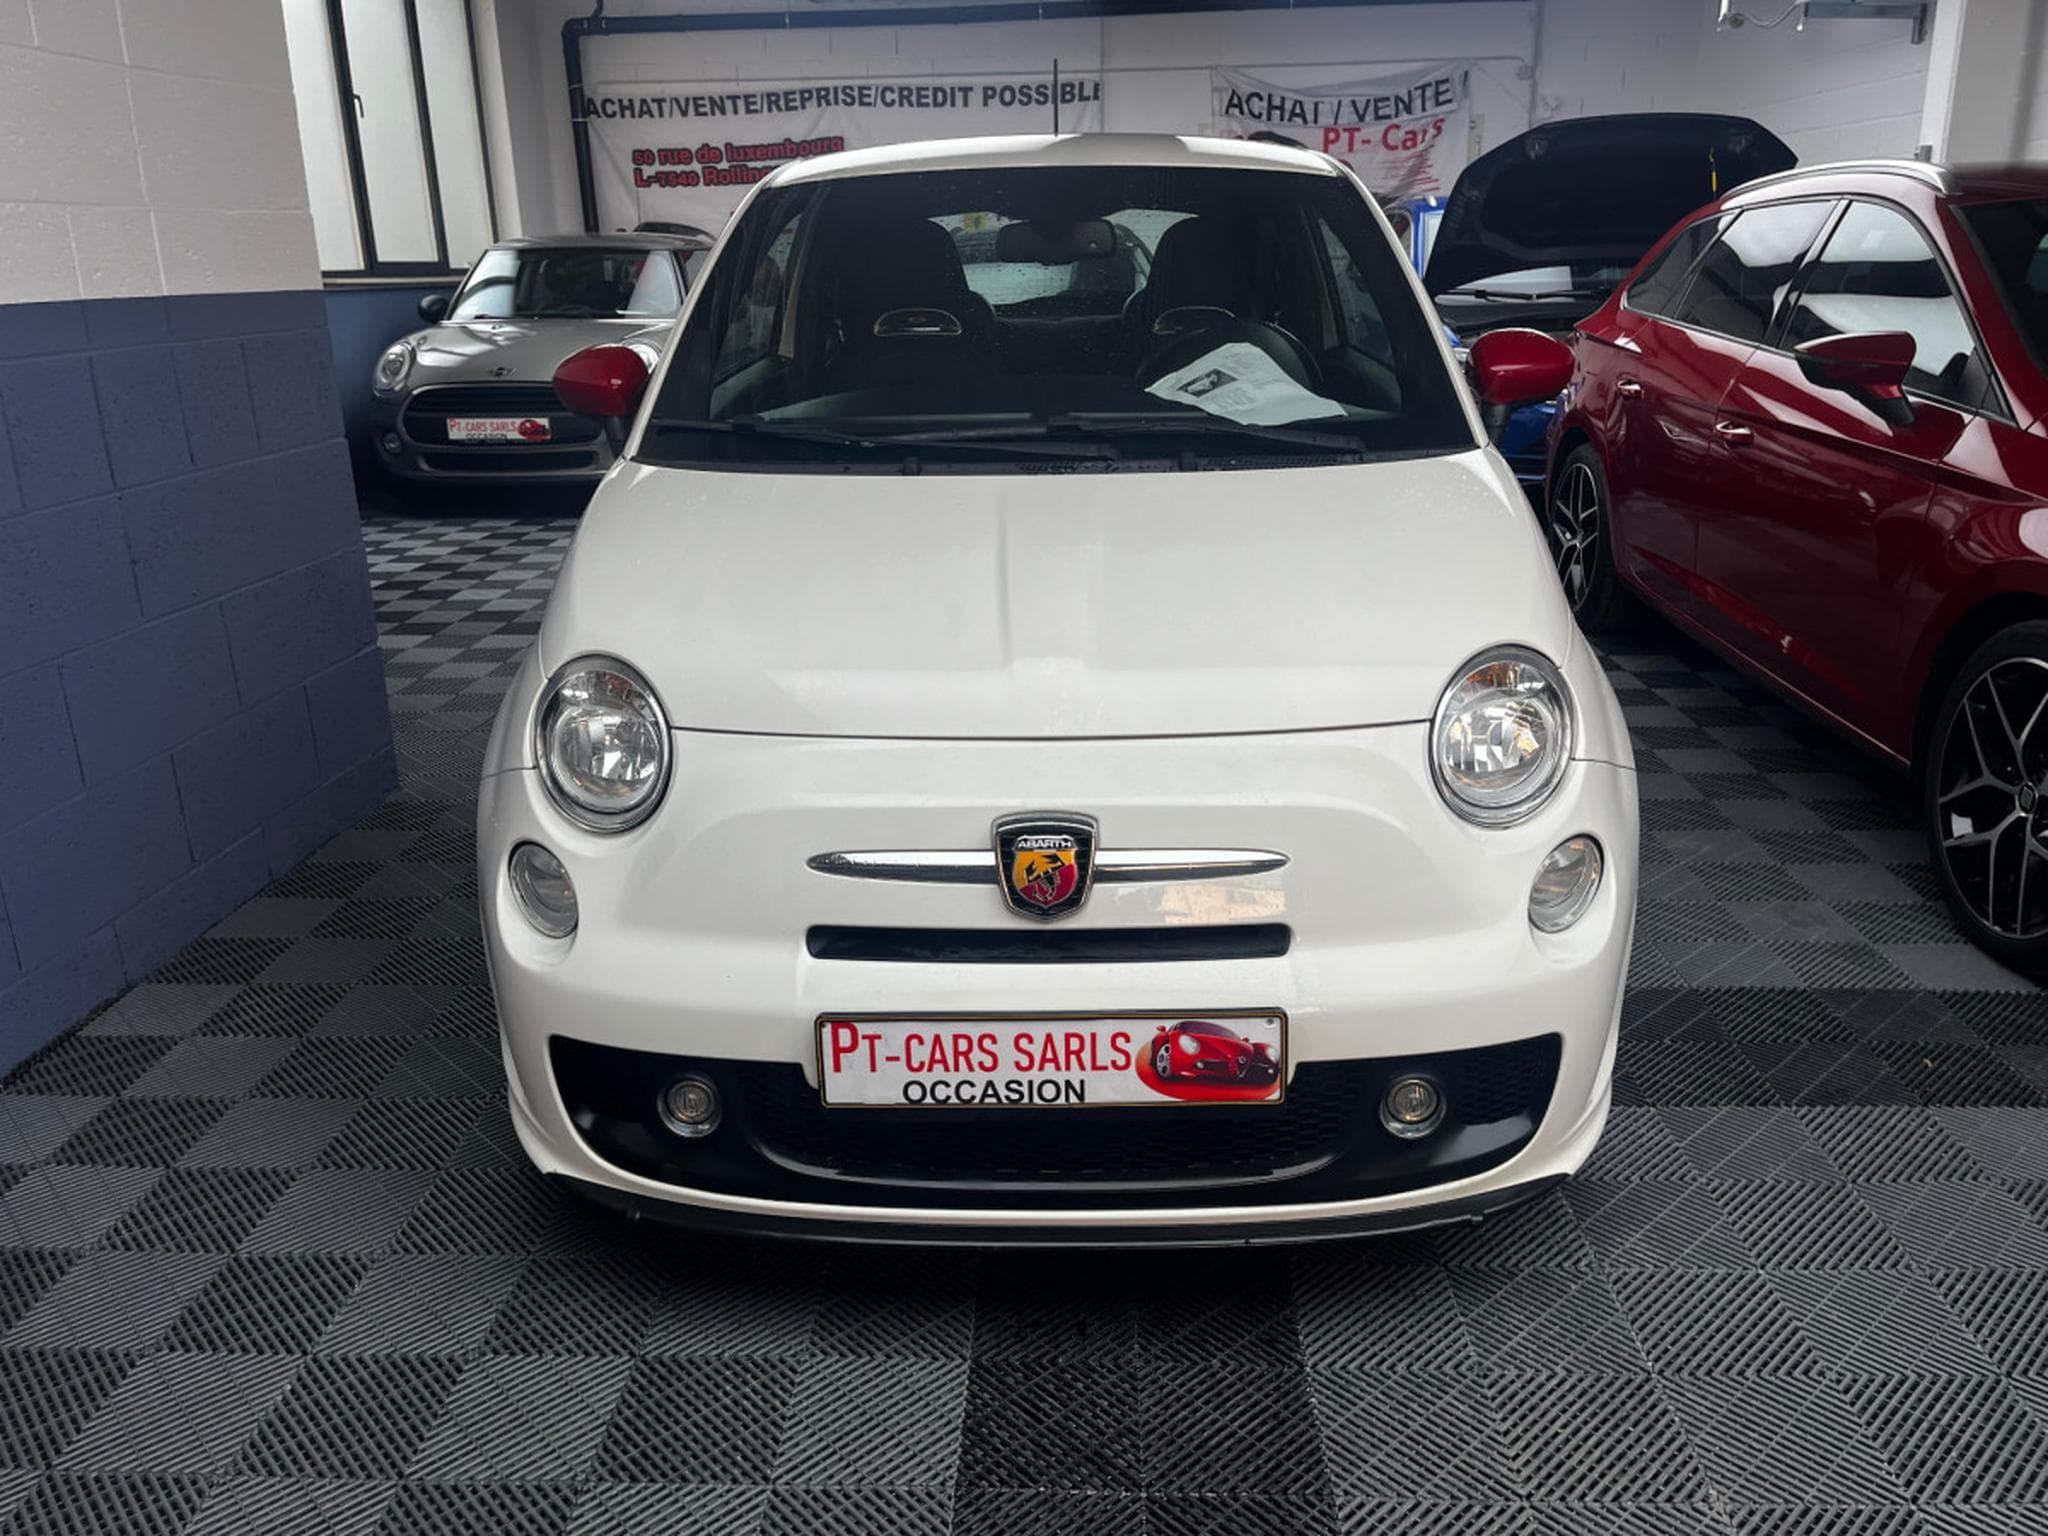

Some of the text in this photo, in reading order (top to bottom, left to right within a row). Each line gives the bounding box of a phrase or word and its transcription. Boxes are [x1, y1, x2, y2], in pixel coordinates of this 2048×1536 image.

[1225, 89, 1325, 125] ACHAT
[1350, 78, 1453, 122] VENTE
[657, 148, 693, 165] rue
[695, 143, 723, 164] de
[1018, 839, 1071, 848] ABARTH
[1013, 1031, 1132, 1073] SARLS
[902, 1079, 1085, 1104] OCCASION
